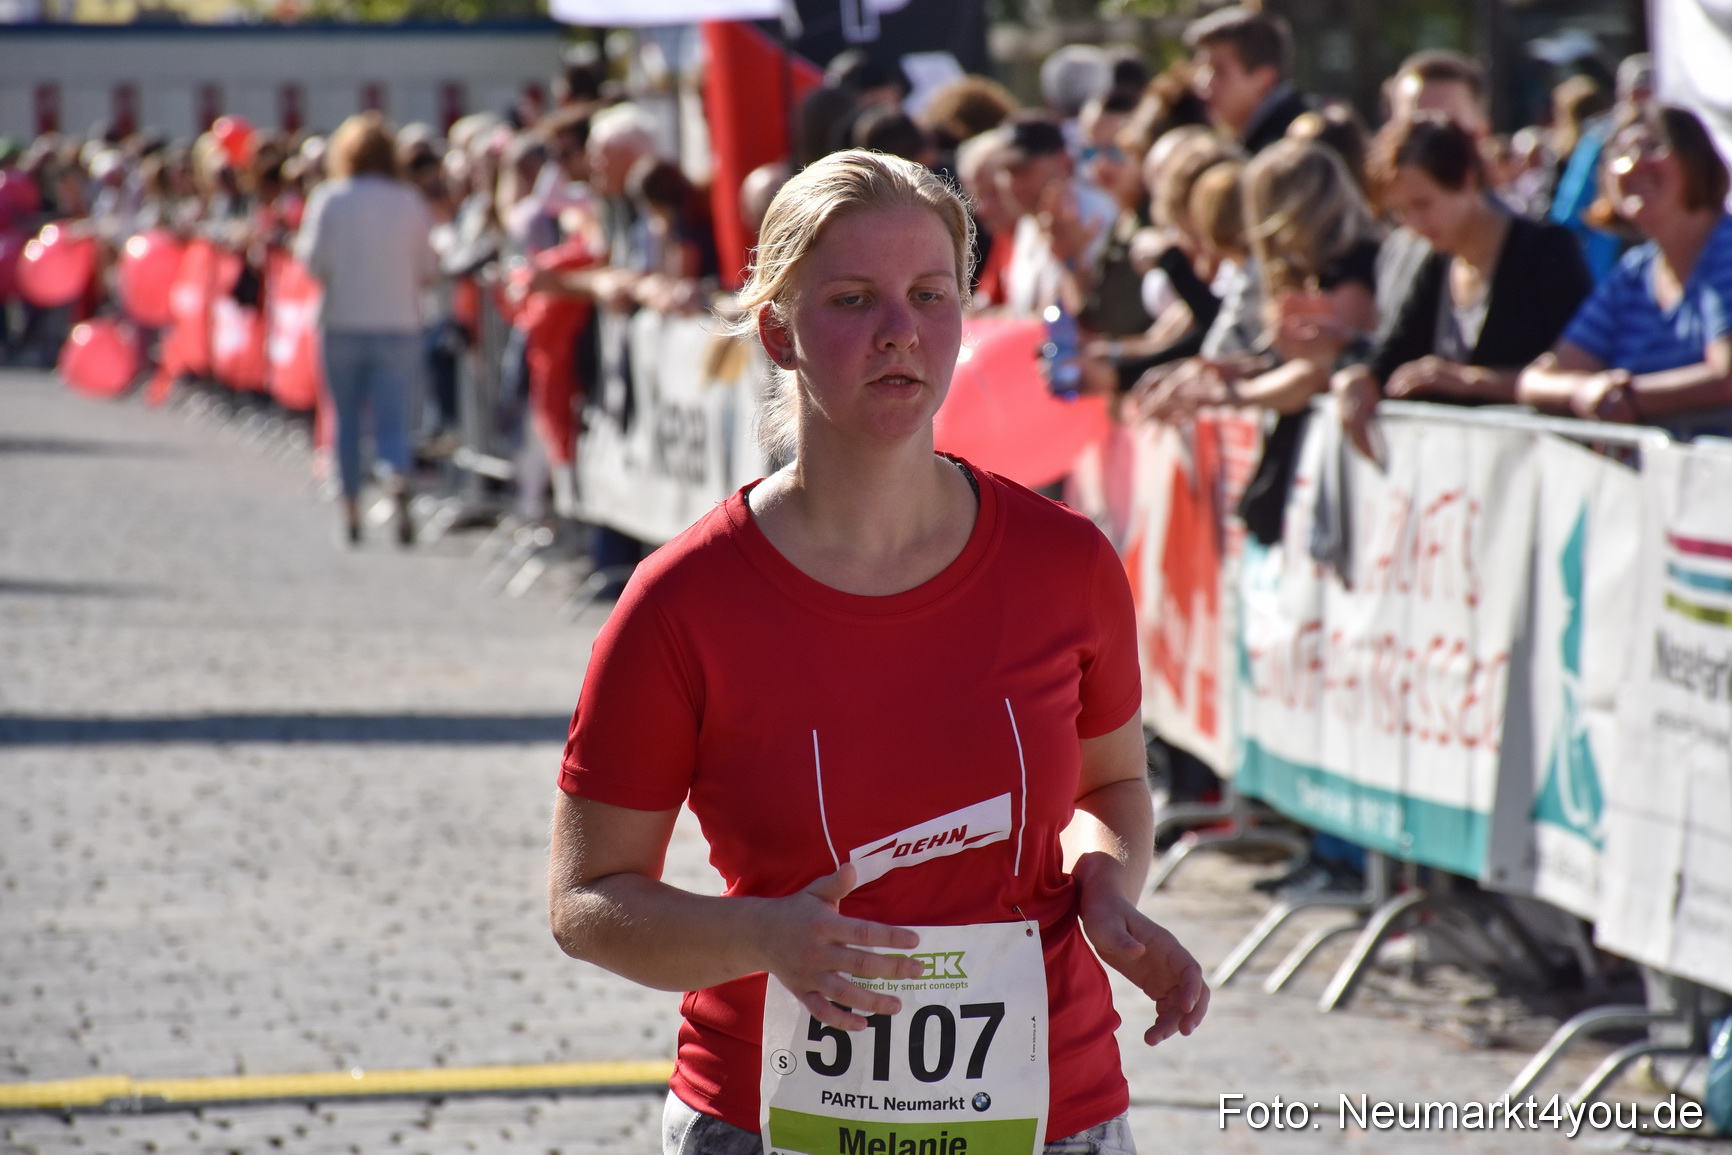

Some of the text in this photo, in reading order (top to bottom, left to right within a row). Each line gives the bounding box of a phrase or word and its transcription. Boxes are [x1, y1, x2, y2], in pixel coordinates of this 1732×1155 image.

[892, 824, 968, 859] DEHN
[887, 982, 898, 992] by
[901, 982, 927, 990] smart
[929, 981, 969, 991] concepts
[805, 1001, 1007, 1083] 5107
[778, 1055, 788, 1069] S
[821, 1090, 965, 1111] PARTL Neumarkt
[839, 1126, 967, 1155] Melanie
